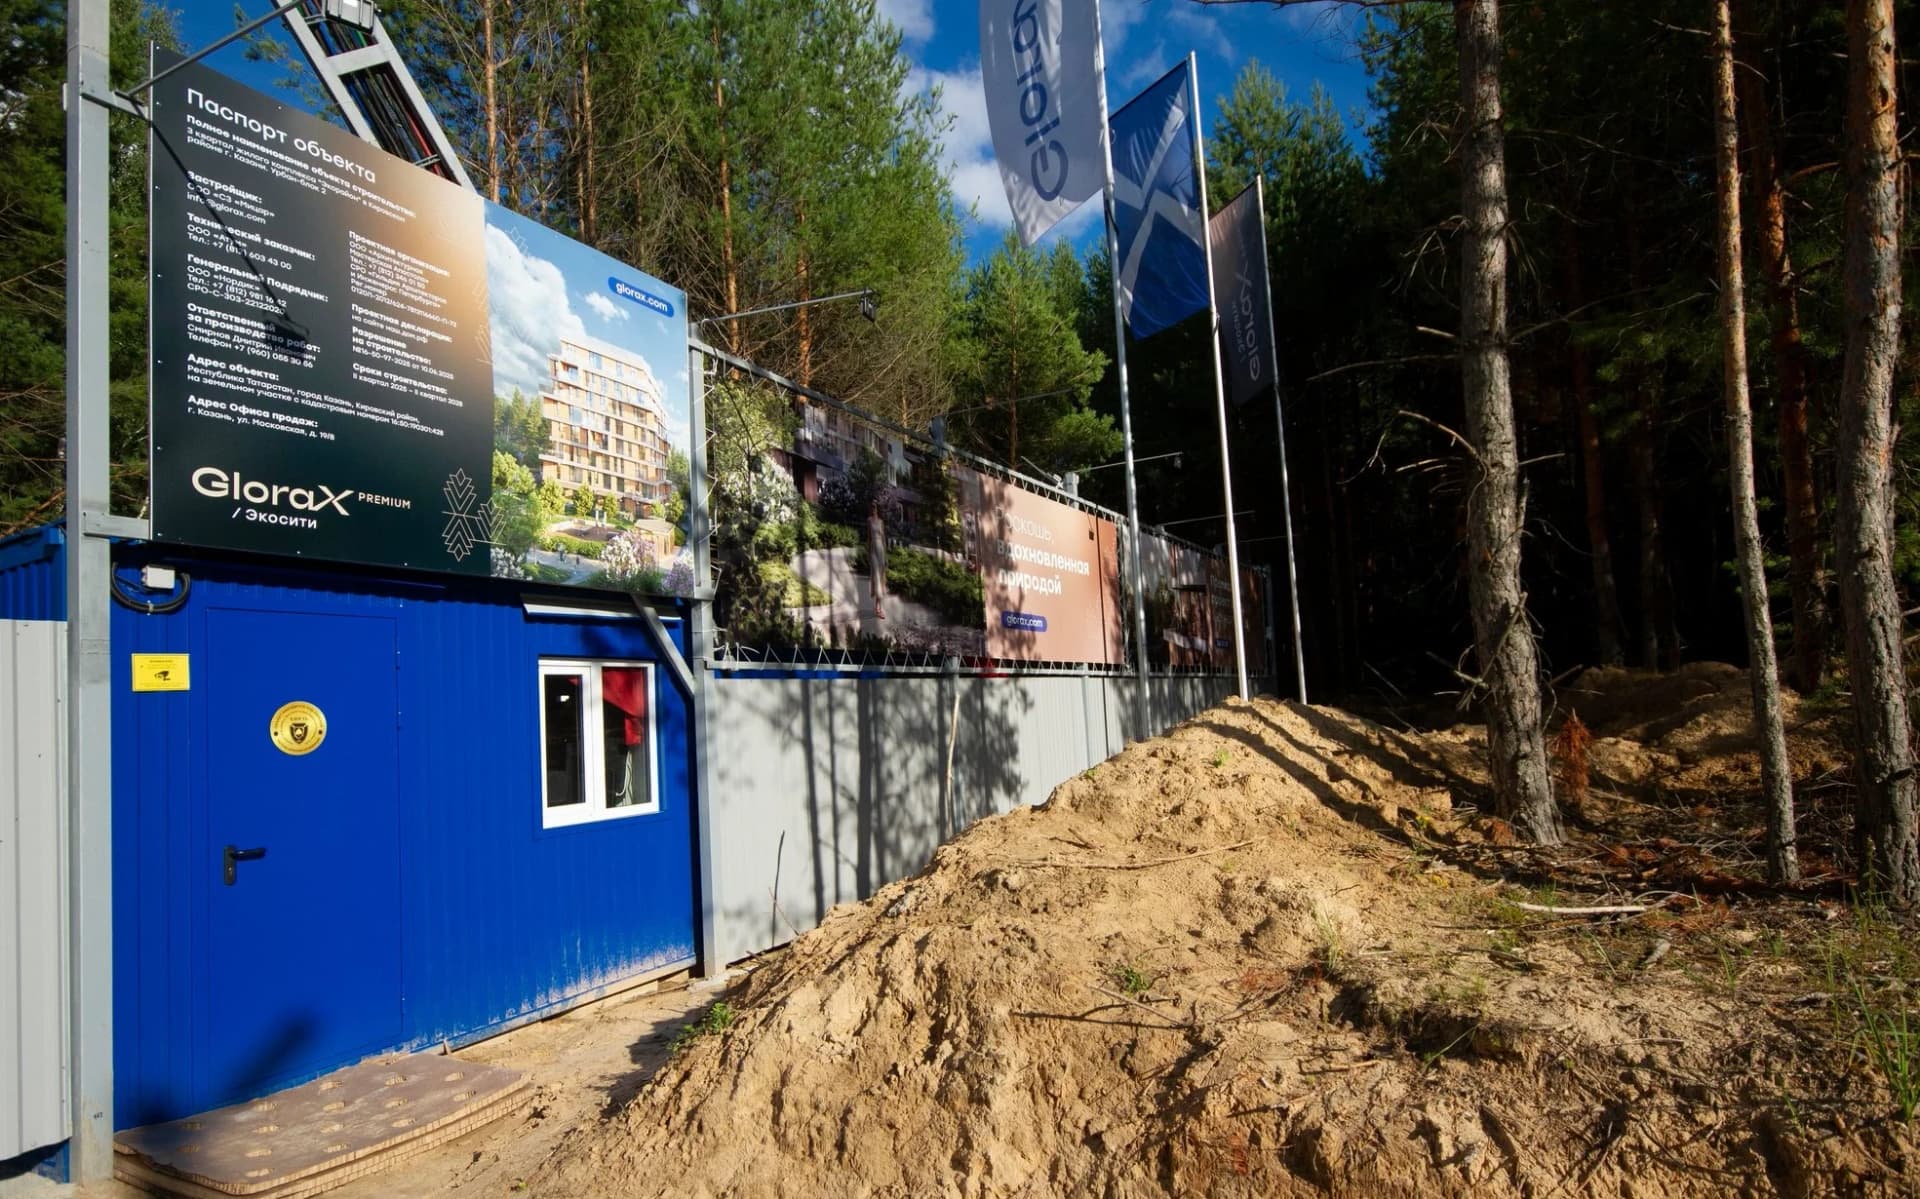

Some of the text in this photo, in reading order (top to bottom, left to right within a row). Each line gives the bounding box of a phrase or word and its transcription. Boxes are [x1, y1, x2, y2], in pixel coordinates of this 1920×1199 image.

[187, 87, 375, 183] Паспорт объекта
[186, 114, 229, 138] Полное
[232, 134, 309, 170] наименование
[311, 166, 350, 189] объекта
[186, 131, 222, 154] районе
[224, 149, 231, 158] г.
[270, 166, 319, 193] Урбан-блок
[187, 126, 193, 135] 3
[195, 130, 233, 151] квартал
[235, 146, 269, 165] жилого
[271, 160, 316, 184] комплекса
[187, 170, 262, 204] Застройщик:
[187, 223, 210, 237] ООО
[349, 230, 395, 256] Проектная
[187, 231, 210, 246] Тел.:
[212, 241, 223, 249] +7
[248, 251, 265, 262] 603
[267, 257, 278, 266] 43
[280, 261, 292, 270] 00
[264, 238, 315, 261] заказчик:
[349, 240, 366, 253] ООО
[350, 255, 367, 267] Тел.:
[368, 263, 376, 271] +7
[350, 263, 366, 274] СРО
[187, 265, 260, 295] ООО «Нордик»
[187, 273, 210, 286] Тел.:
[212, 281, 223, 290] +7
[225, 284, 246, 298] (812)
[249, 290, 263, 301] 981
[265, 295, 273, 304] 16
[266, 276, 328, 303] Подрядчик:
[615, 282, 667, 313] glorax.com
[187, 302, 275, 332] Ответственный
[351, 303, 399, 326] Проектная
[351, 314, 361, 322] на
[362, 317, 384, 329] сайте
[187, 313, 320, 353] за производство работ:
[187, 323, 230, 341] Смирнов
[232, 334, 272, 351] Дмитрий
[187, 331, 231, 349] Телефон
[233, 344, 244, 352] +7
[247, 346, 270, 360] (960)
[272, 352, 288, 362] 055
[352, 325, 406, 349] Разрешение
[352, 335, 364, 345] на
[187, 353, 279, 381] Адрес объекта:
[352, 362, 382, 377] Сроки
[187, 364, 420, 423] Республика Татарстан, город Казань, Кировский район,
[187, 374, 200, 383] на
[202, 377, 254, 394] земельном
[256, 388, 292, 402] участке
[300, 398, 355, 416] кадастровым
[356, 410, 389, 424] номером
[358, 375, 389, 388] квартал
[419, 391, 447, 403] квартал
[187, 394, 318, 428] Адрес Офиса продаж:
[187, 406, 195, 414] г.
[197, 407, 234, 423] Казань,
[236, 416, 250, 425] ул.
[252, 418, 307, 437] Московская,
[308, 430, 317, 438] д.
[191, 466, 410, 517] GloraX PREMIUM
[245, 508, 317, 529] Экосити
[997, 539, 1090, 576] вдохновленная
[998, 569, 1062, 595] природой
[1006, 614, 1043, 629] glorax.com
